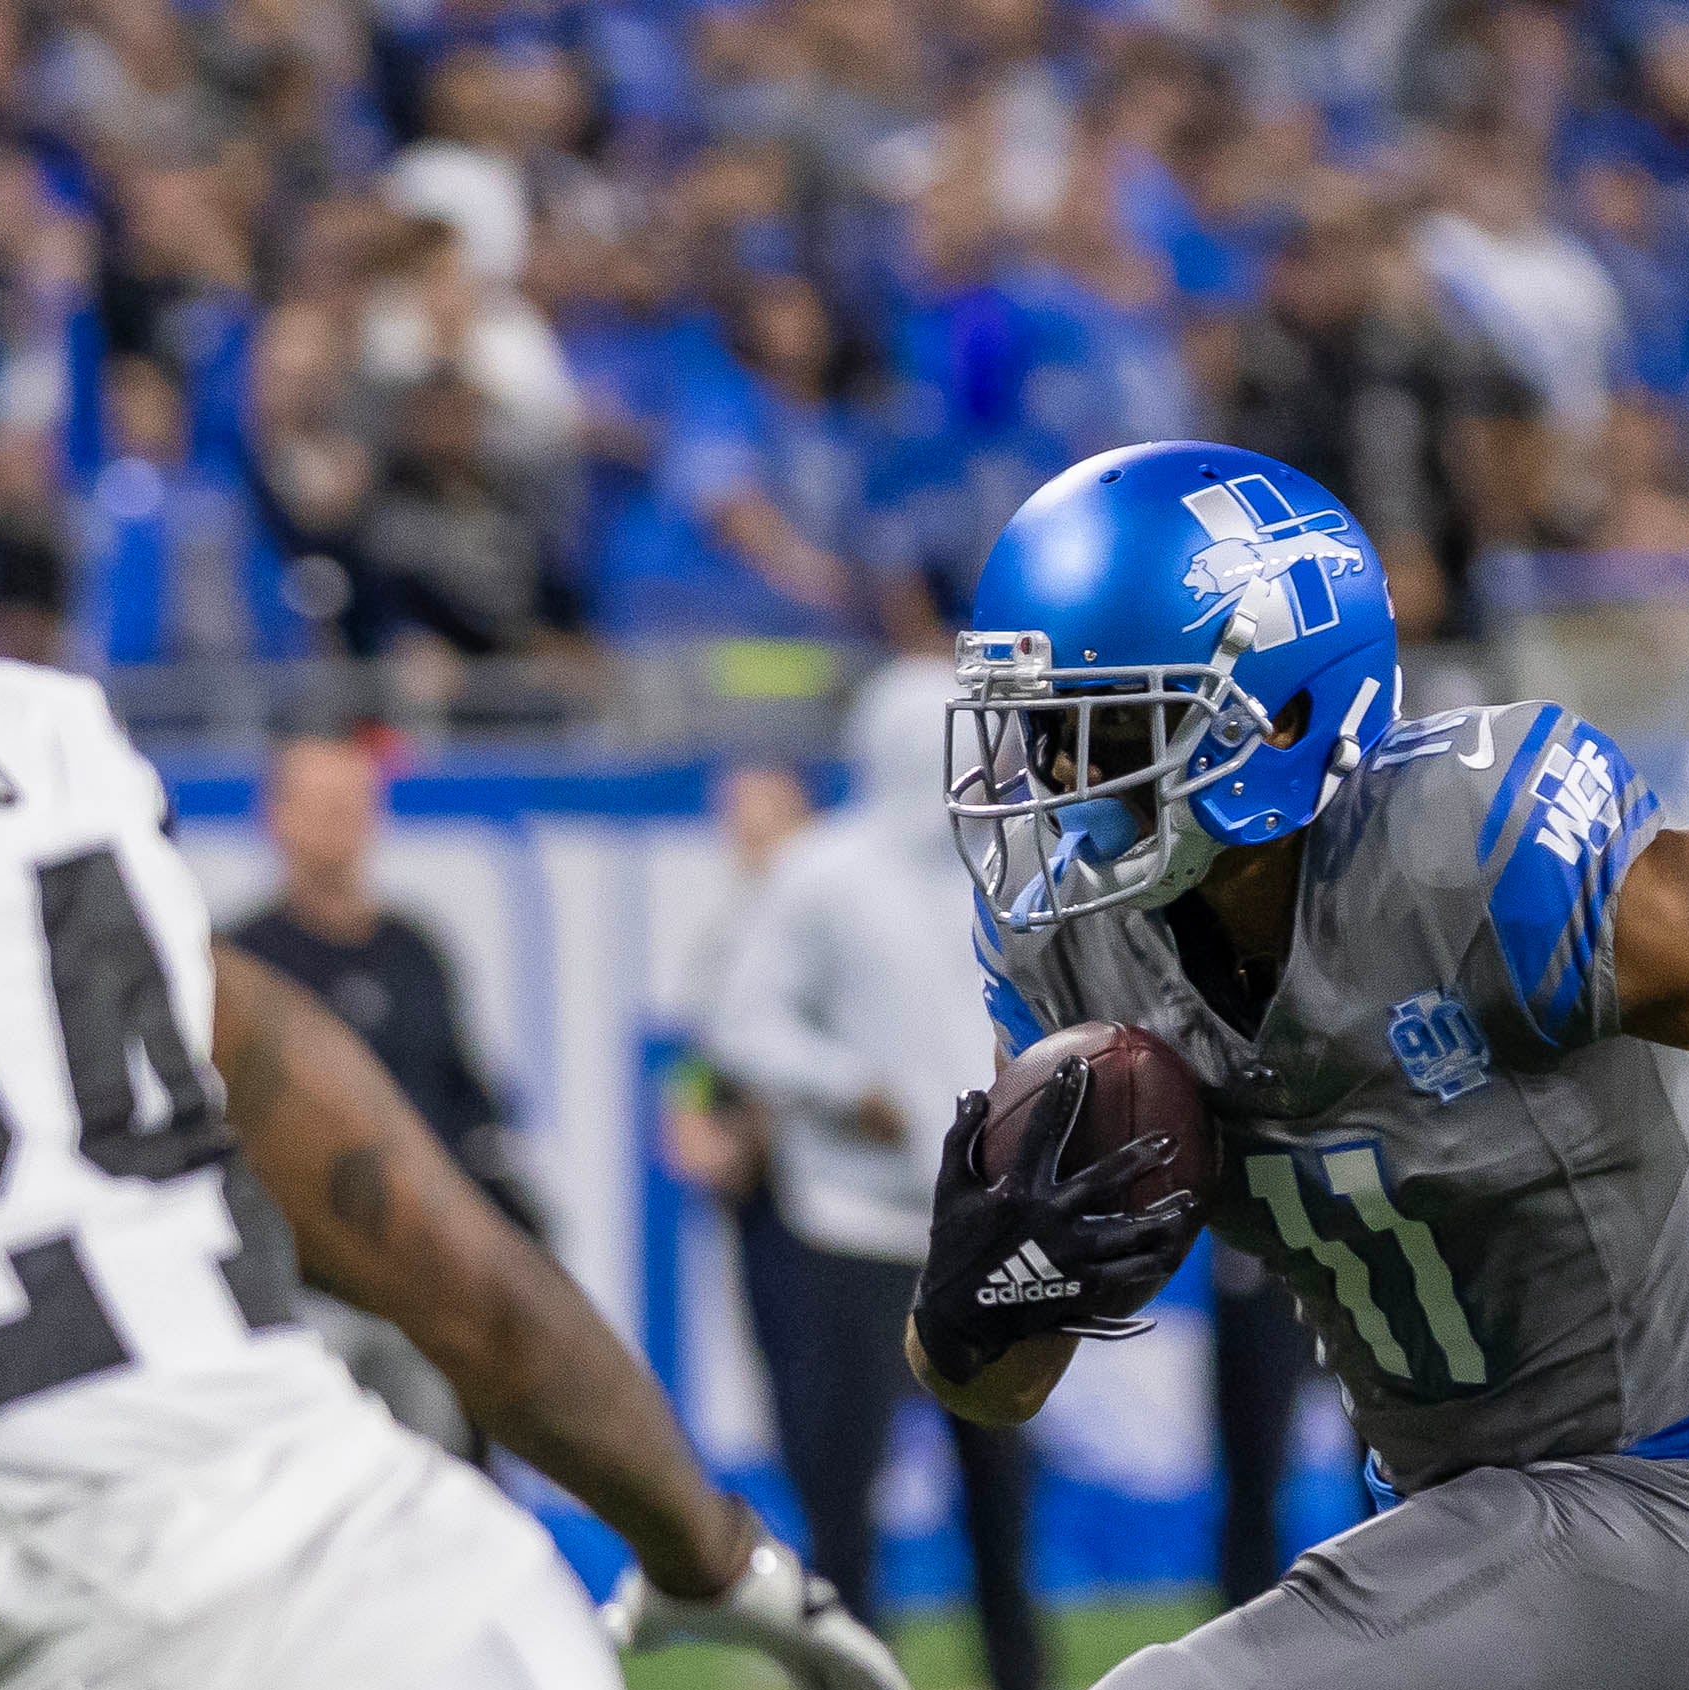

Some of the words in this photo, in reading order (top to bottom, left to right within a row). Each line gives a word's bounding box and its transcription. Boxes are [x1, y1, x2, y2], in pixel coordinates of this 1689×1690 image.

[1535, 738, 1613, 867] WCF
[976, 1281, 1081, 1305] adidas
[1244, 1146, 1488, 1384] 11
